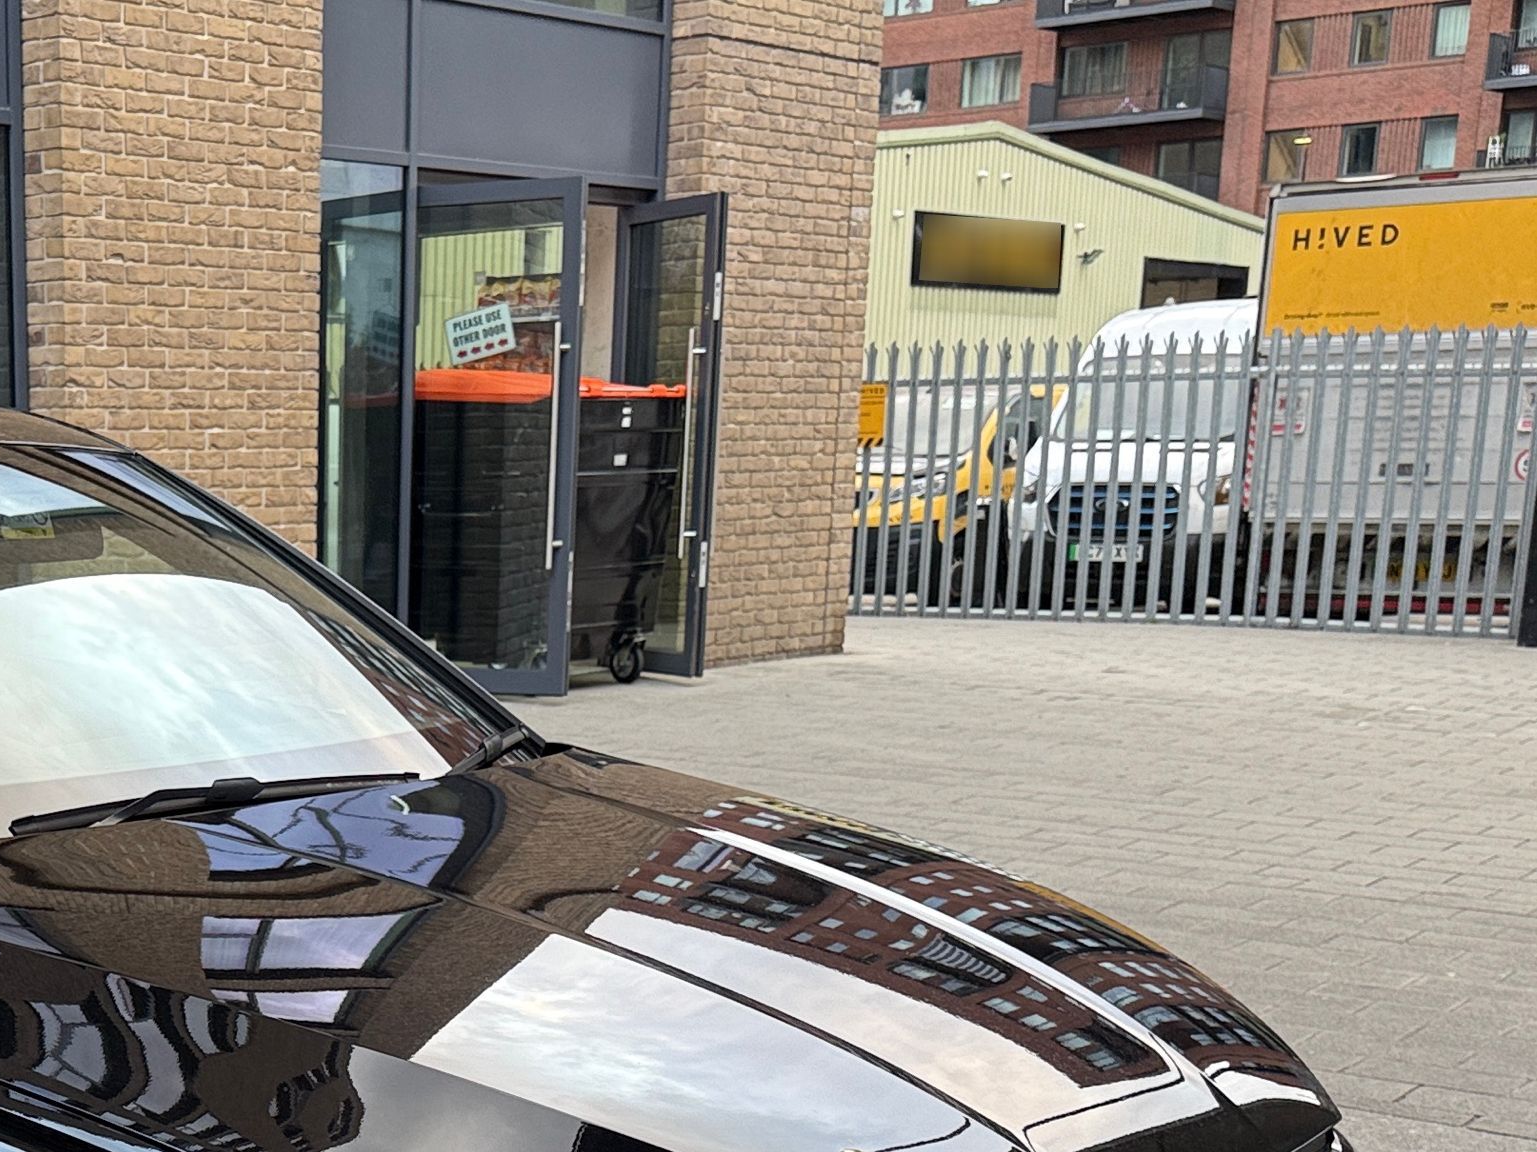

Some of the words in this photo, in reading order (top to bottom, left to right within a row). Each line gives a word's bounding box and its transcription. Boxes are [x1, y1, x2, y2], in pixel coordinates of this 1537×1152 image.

[452, 315, 483, 333] PLEASE
[485, 309, 502, 323] USE
[453, 331, 480, 347] OTHER
[482, 323, 507, 339] DOOR
